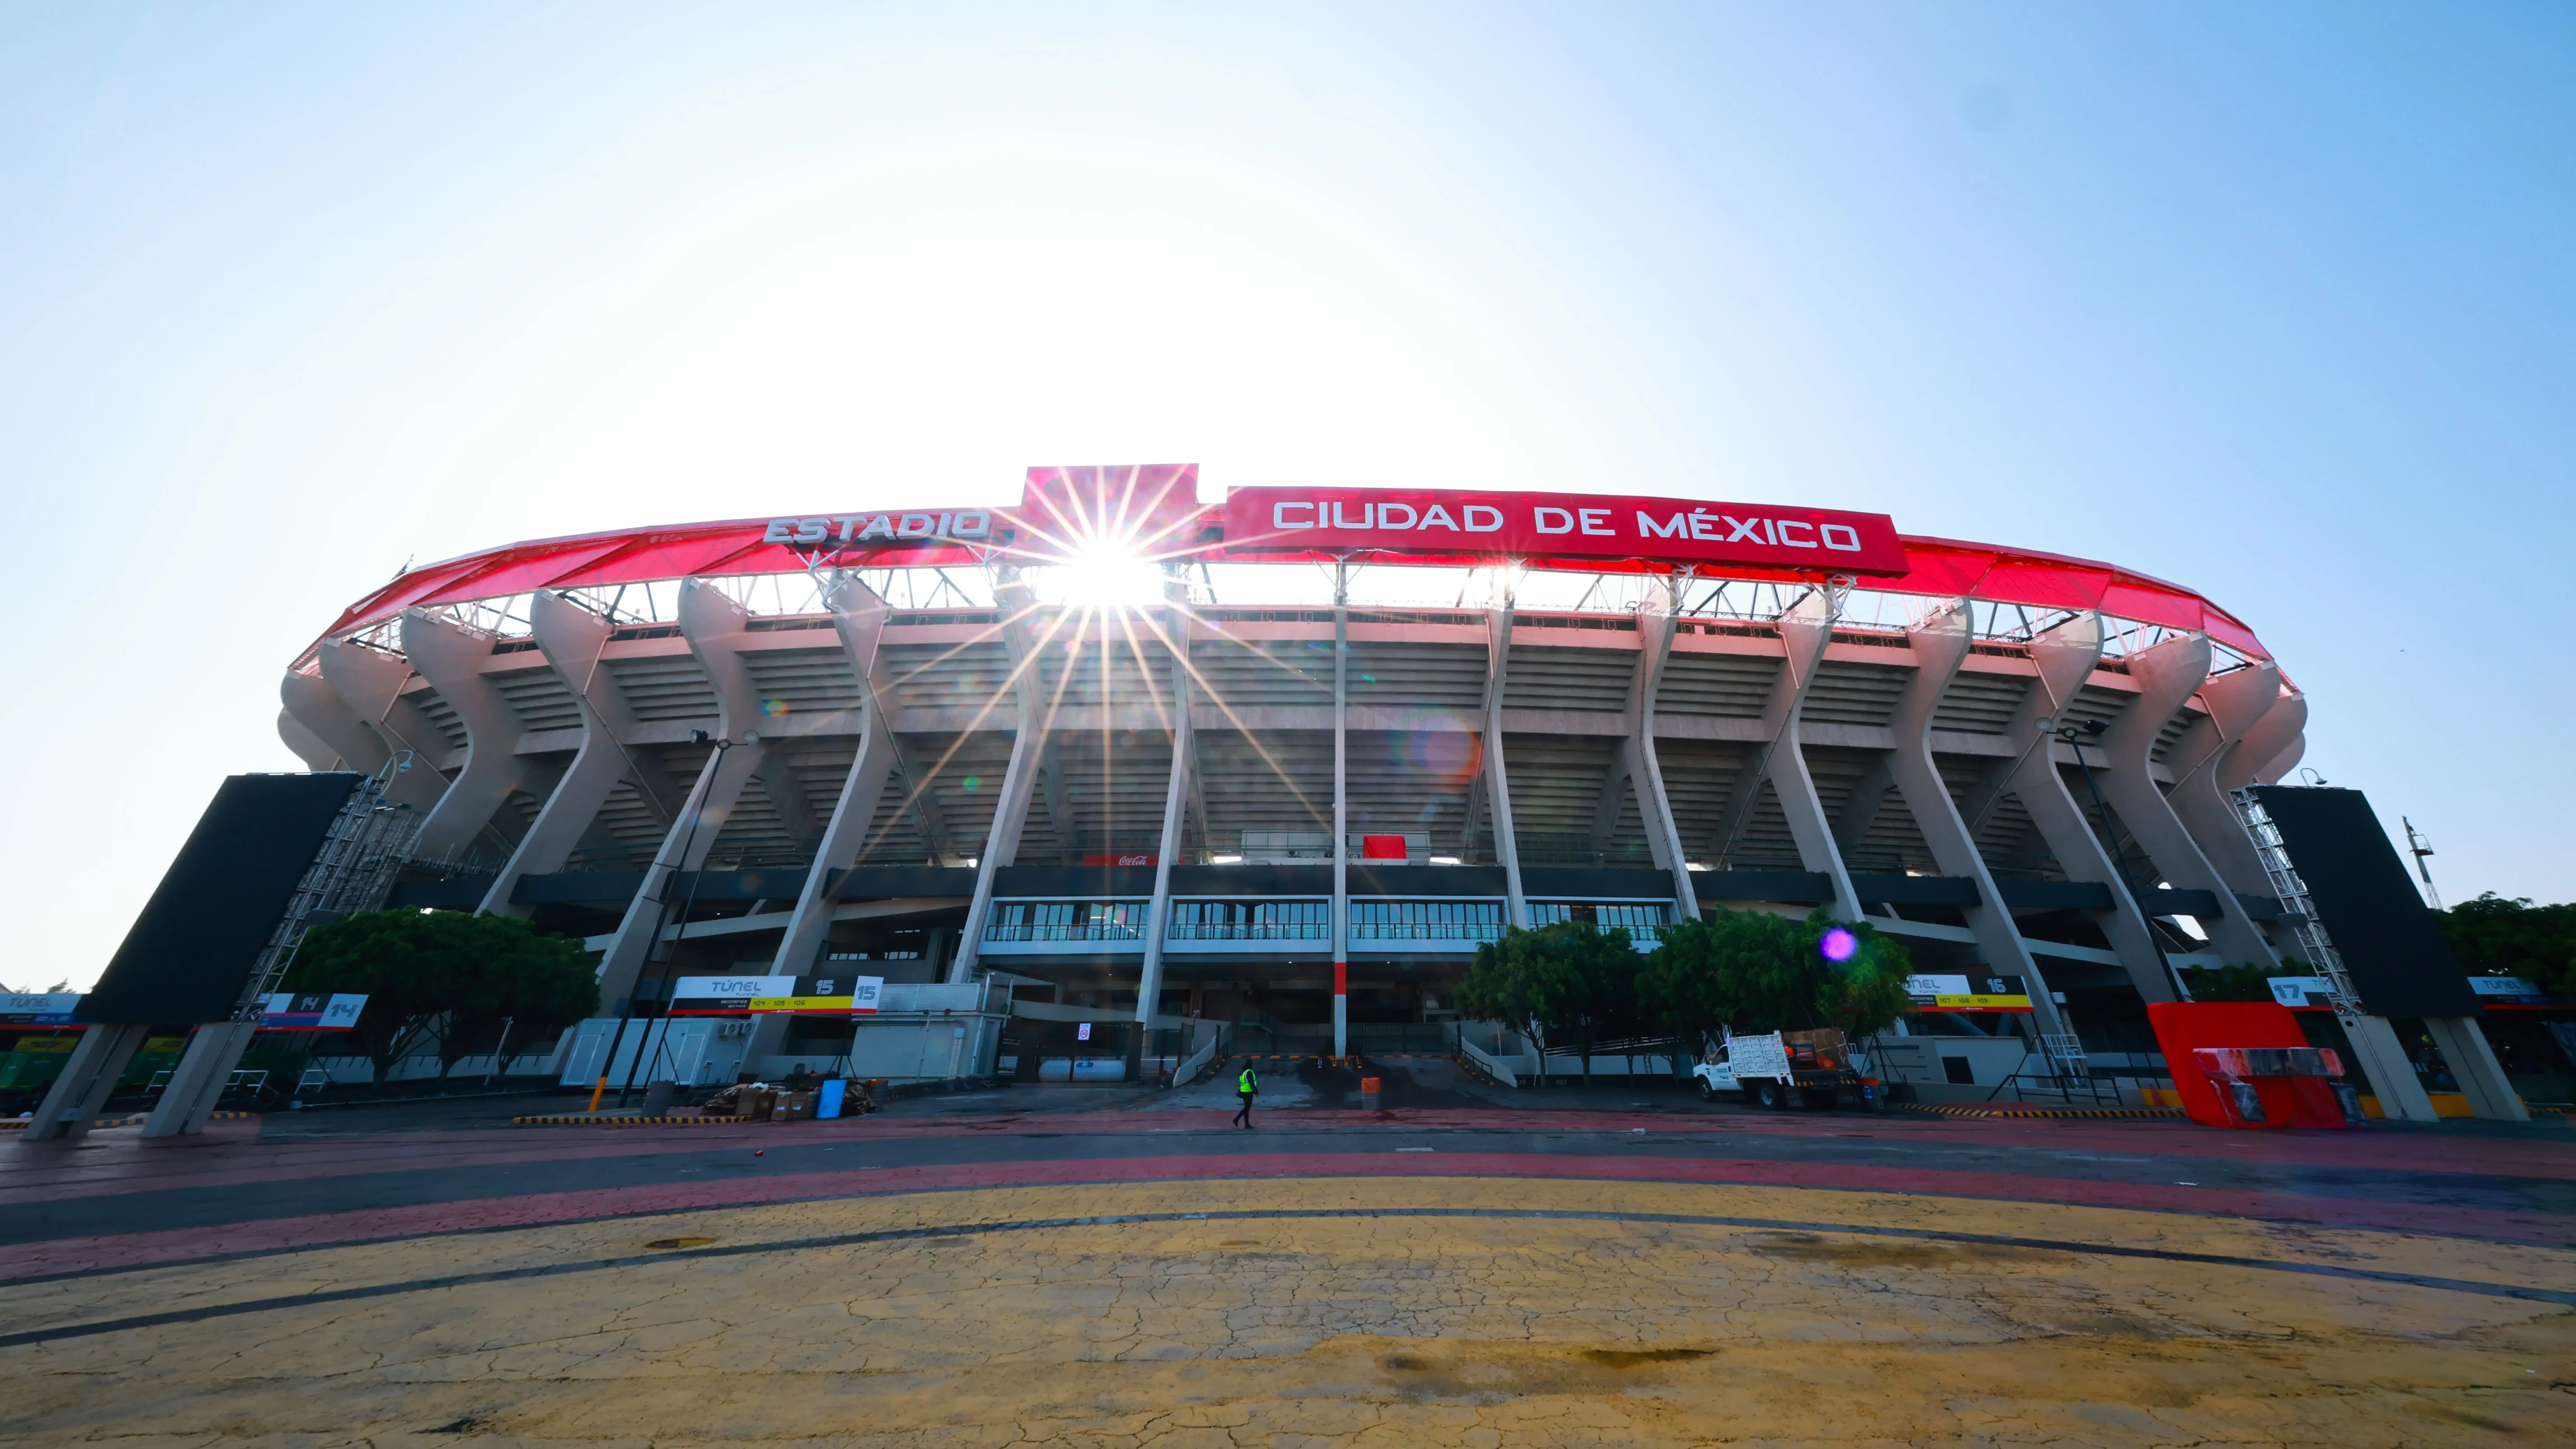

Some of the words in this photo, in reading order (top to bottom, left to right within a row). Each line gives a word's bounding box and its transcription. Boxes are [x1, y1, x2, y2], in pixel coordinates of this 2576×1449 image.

[763, 511, 991, 543] ESTADIO
[1273, 501, 1504, 531] CIUDAD
[1534, 506, 1615, 536] DE
[1636, 507, 1862, 552] MÉXICO
[712, 980, 761, 992] TÚNEL
[816, 980, 834, 994] 15
[857, 985, 876, 1000] 15
[1987, 978, 2006, 993] 16
[2274, 984, 2299, 999] 17
[301, 997, 320, 1010] 14
[331, 1004, 358, 1018] 14
